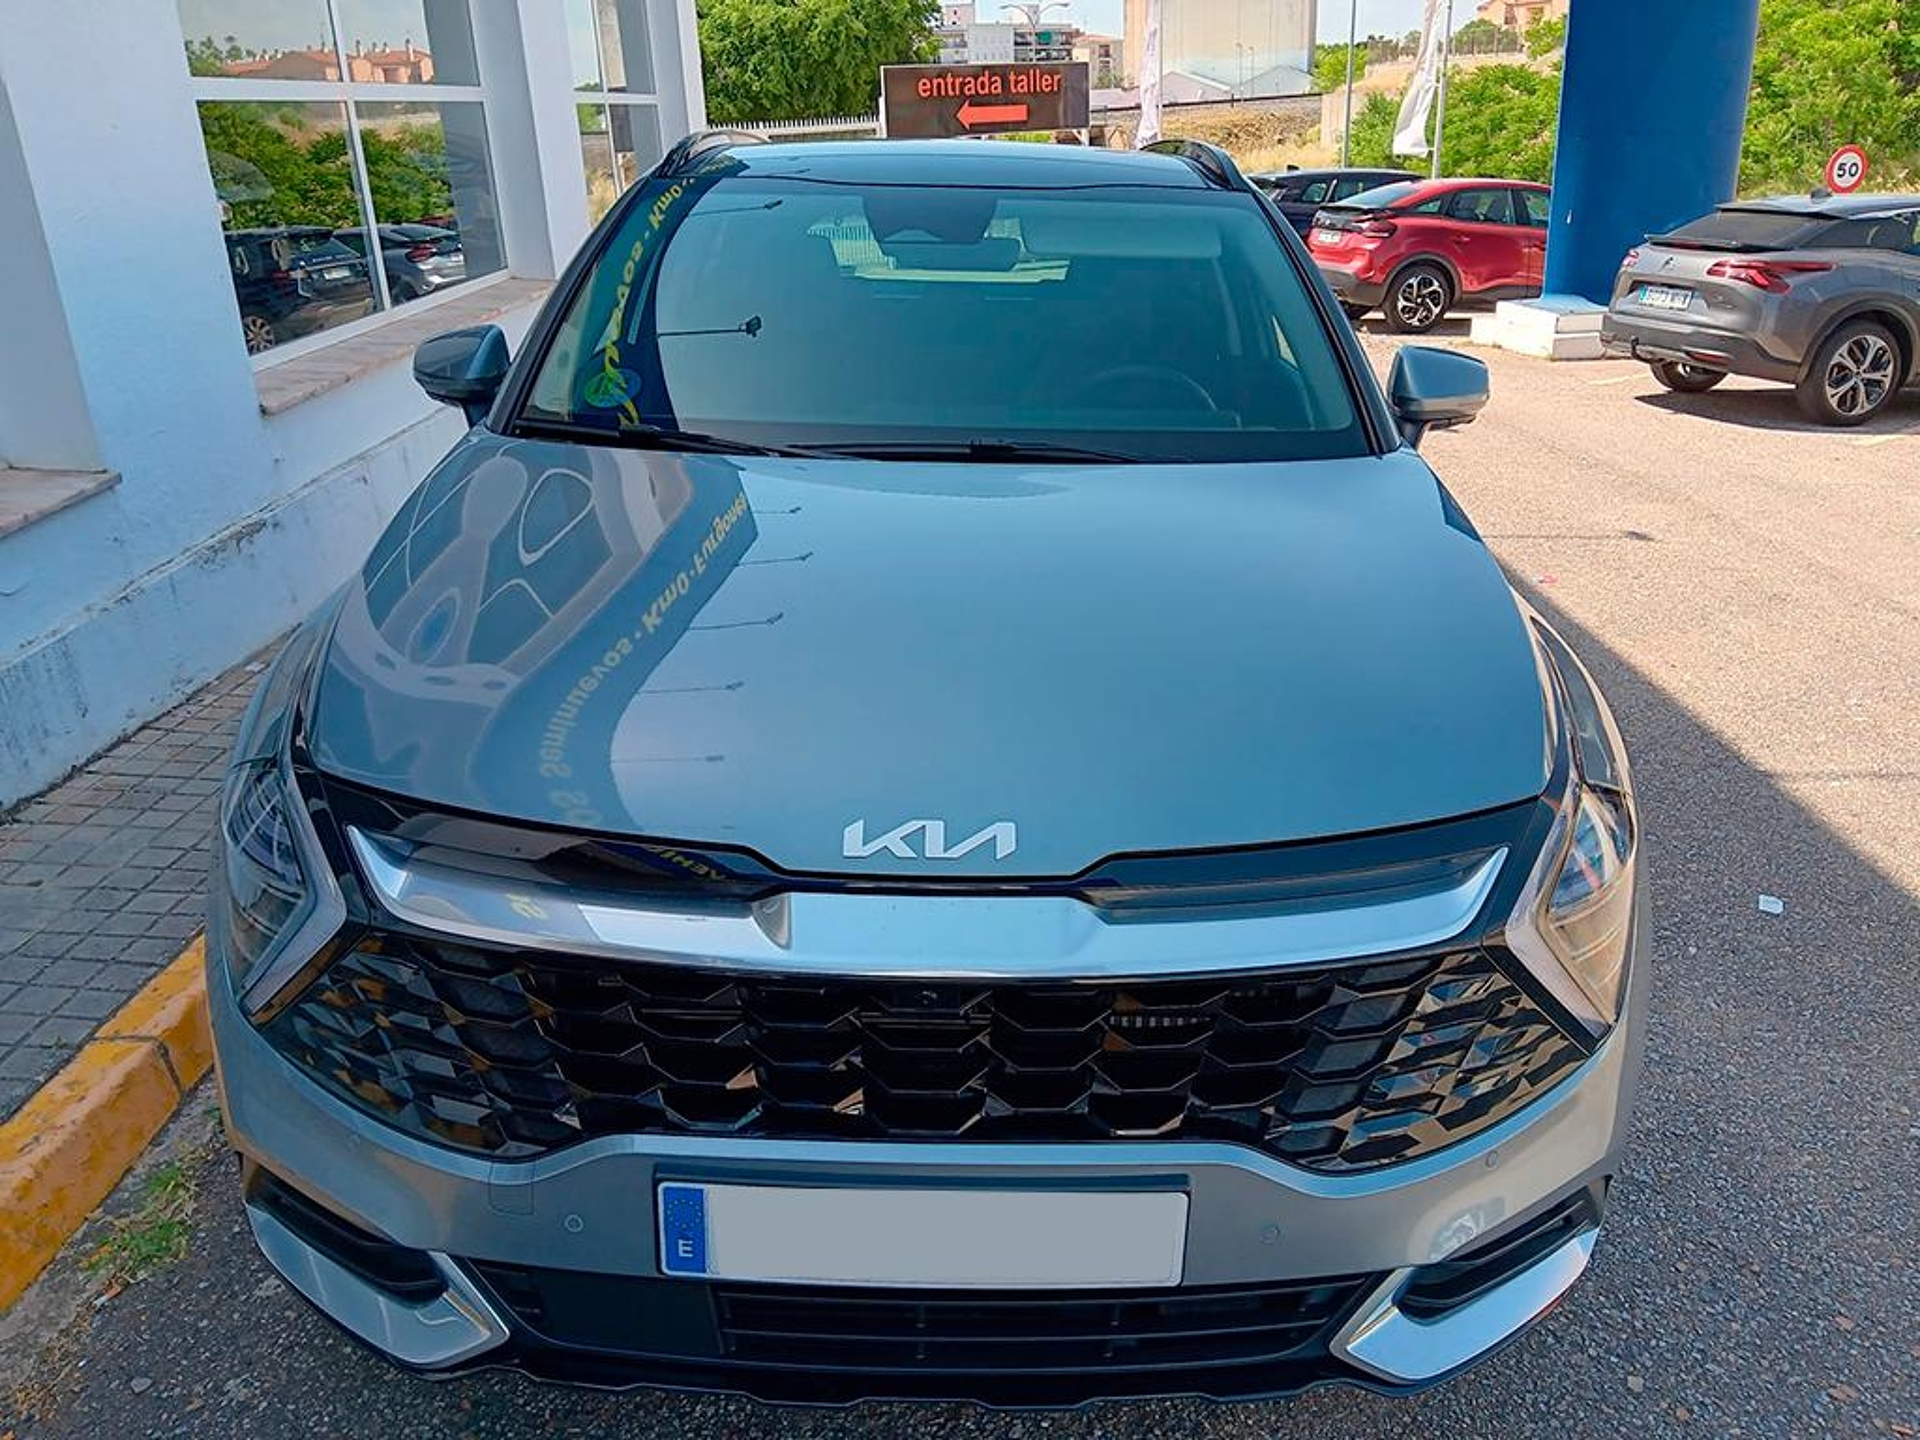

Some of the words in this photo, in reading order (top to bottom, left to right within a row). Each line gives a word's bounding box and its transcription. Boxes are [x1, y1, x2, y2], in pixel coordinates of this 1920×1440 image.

[918, 70, 1001, 97] entrada
[1009, 68, 1062, 92] taller
[1837, 162, 1859, 178] 50
[843, 818, 1016, 860] KIA
[678, 1239, 693, 1257] E
